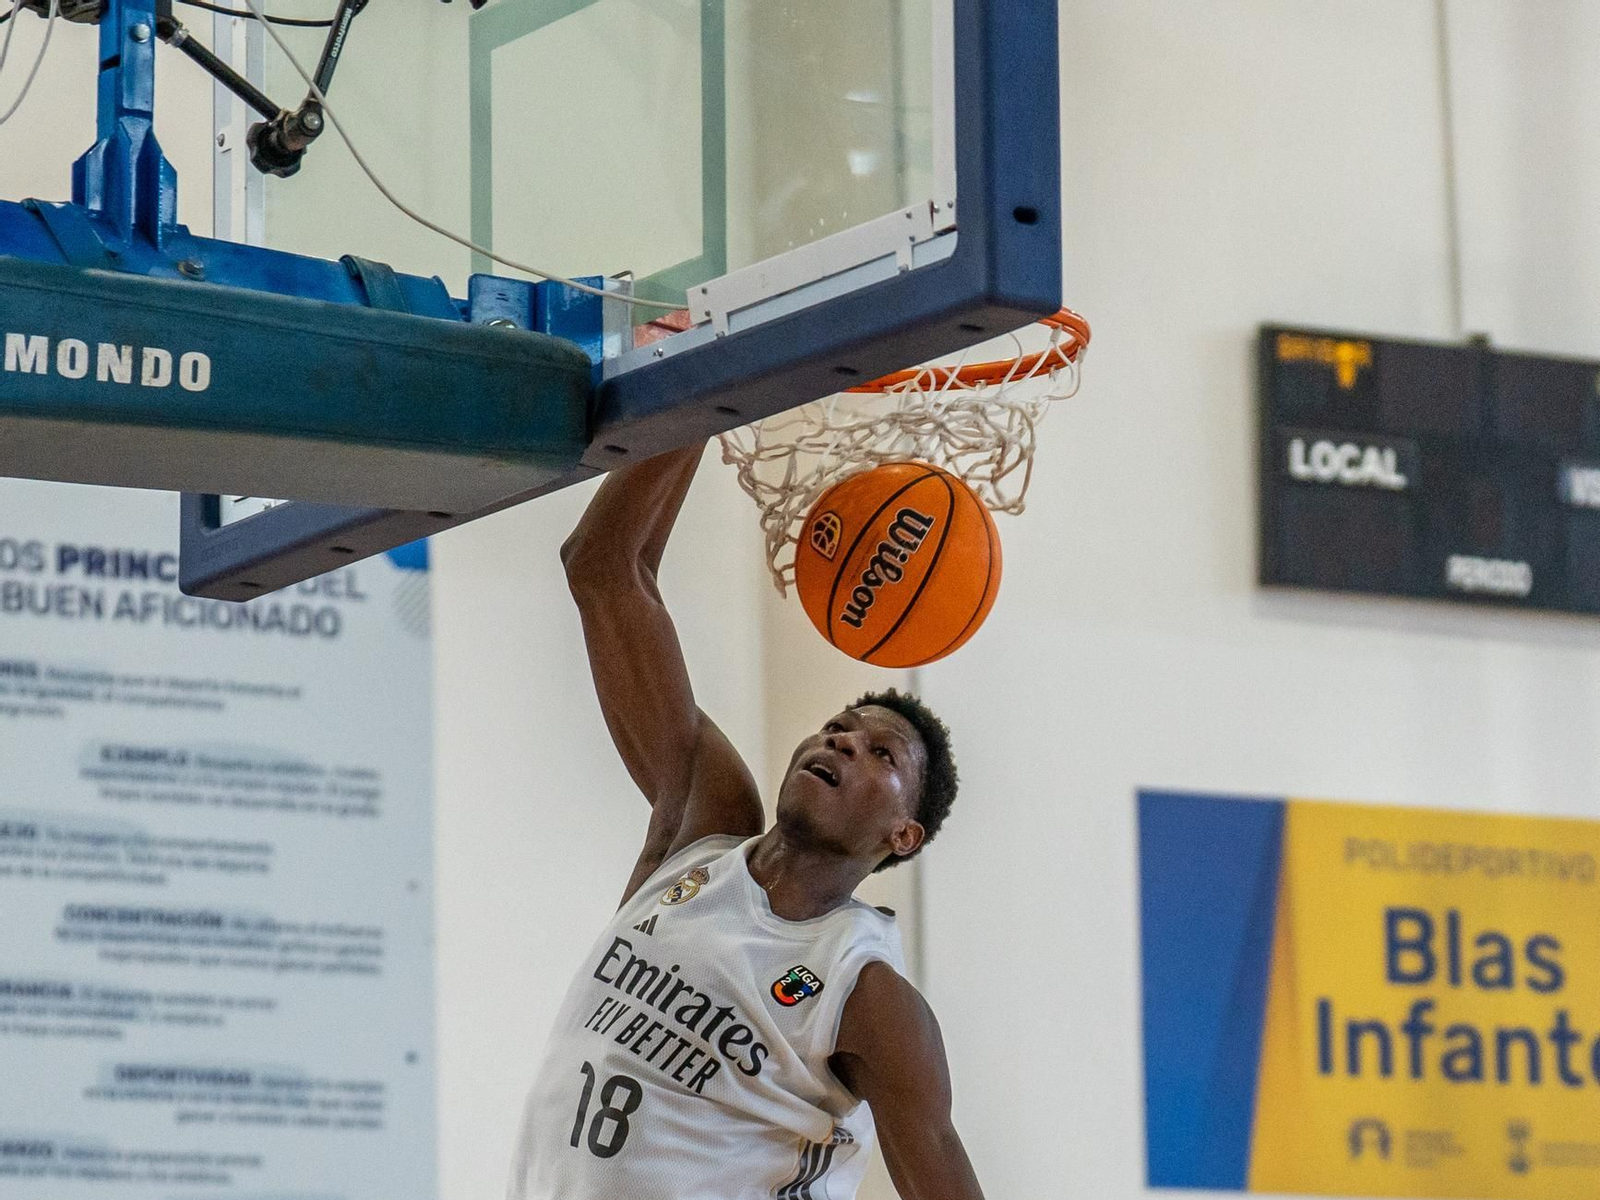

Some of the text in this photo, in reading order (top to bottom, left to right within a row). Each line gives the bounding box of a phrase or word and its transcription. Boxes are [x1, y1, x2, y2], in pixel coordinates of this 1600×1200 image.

[4, 332, 211, 392] MONDO
[1289, 438, 1407, 489] LOCAL
[2, 580, 343, 639] BUEN AFICIONADO
[840, 507, 936, 629] Wilson
[794, 966, 820, 992] LIGA
[1384, 906, 1567, 994] Blas
[584, 997, 721, 1094] FLY BETTER
[593, 936, 768, 1077] Emirates
[570, 1061, 643, 1159] 18
